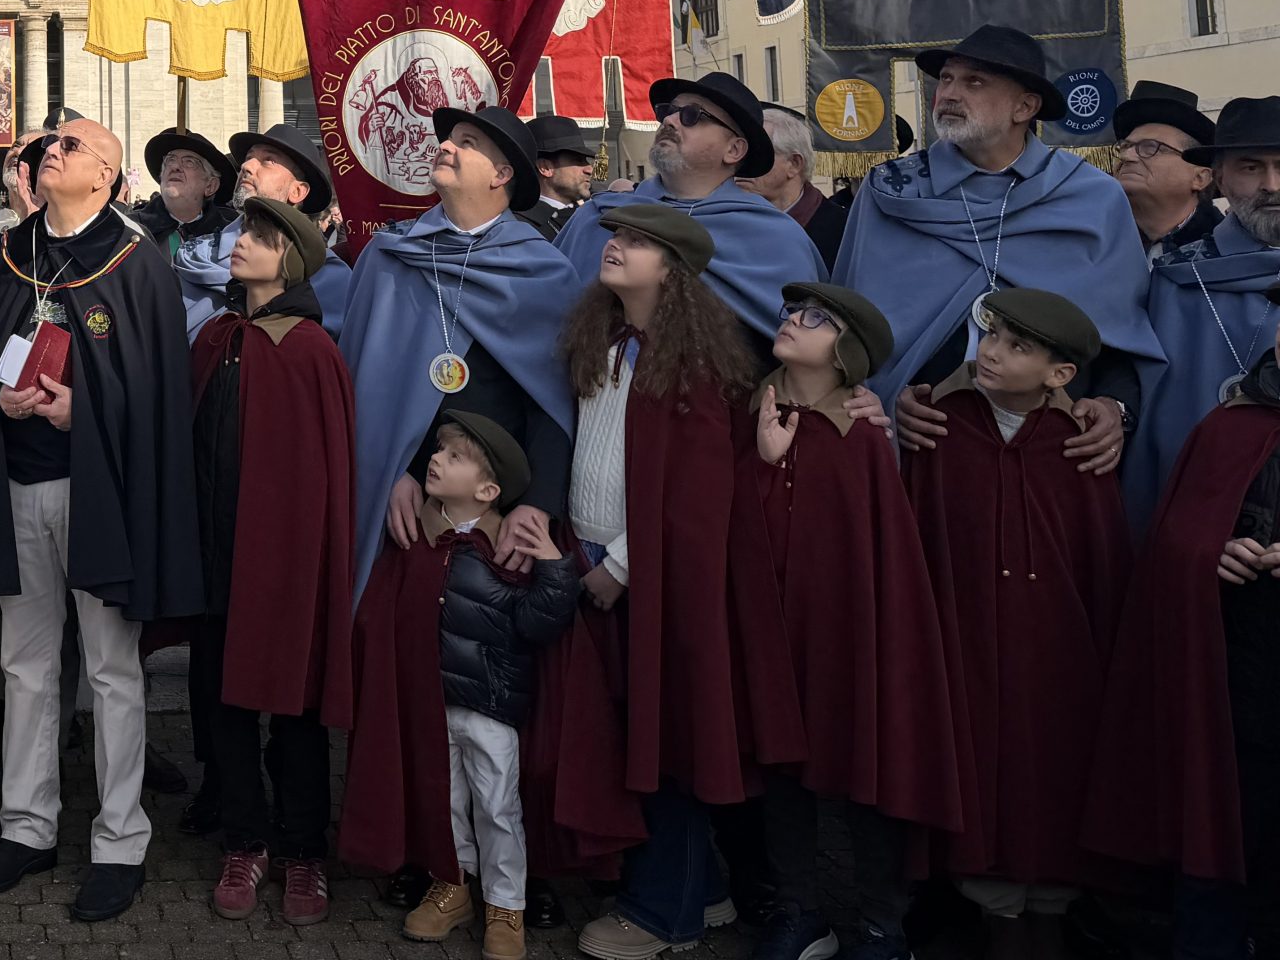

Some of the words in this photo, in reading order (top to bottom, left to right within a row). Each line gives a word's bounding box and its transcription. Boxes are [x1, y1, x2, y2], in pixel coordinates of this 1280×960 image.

[406, 5, 420, 25] DI
[335, 14, 395, 65] PIATTO
[1069, 72, 1099, 82] RIONE
[319, 72, 344, 105] DEL
[835, 83, 864, 92] RIONE
[1066, 119, 1080, 130] DEL
[1082, 116, 1105, 130] CAMPO
[832, 127, 868, 137] FORNACI
[319, 117, 354, 176] PRIORI
[346, 220, 356, 234] S.
